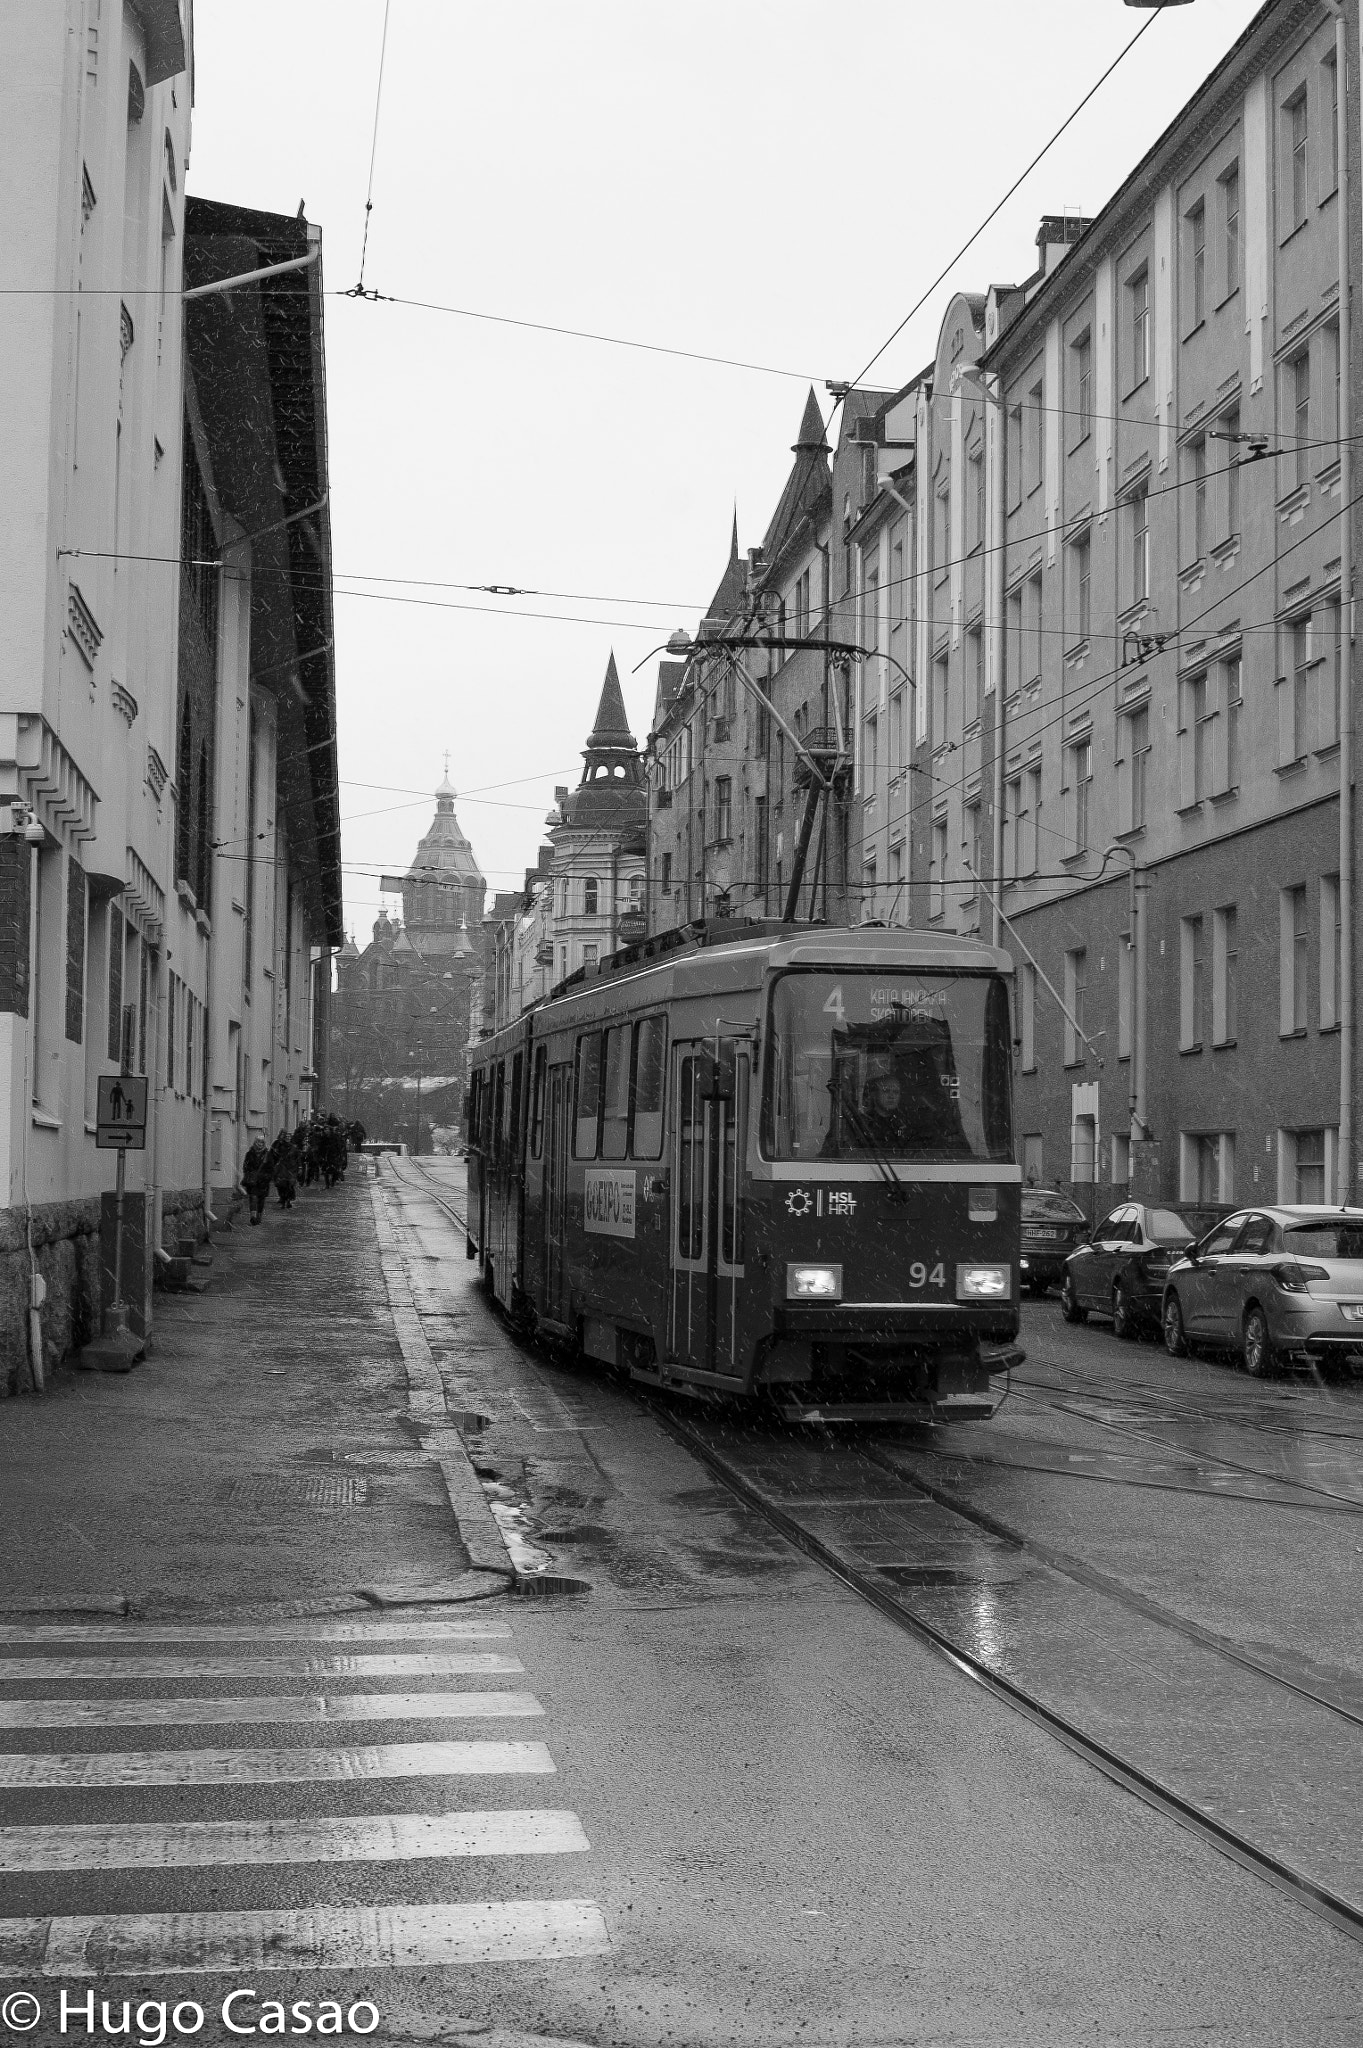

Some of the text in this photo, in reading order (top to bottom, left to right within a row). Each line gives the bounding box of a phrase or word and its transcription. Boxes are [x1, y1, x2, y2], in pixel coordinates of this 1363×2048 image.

[822, 984, 845, 1022] 4
[828, 1191, 857, 1203] HSL
[828, 1203, 857, 1216] HRT
[908, 1262, 946, 1288] 94
